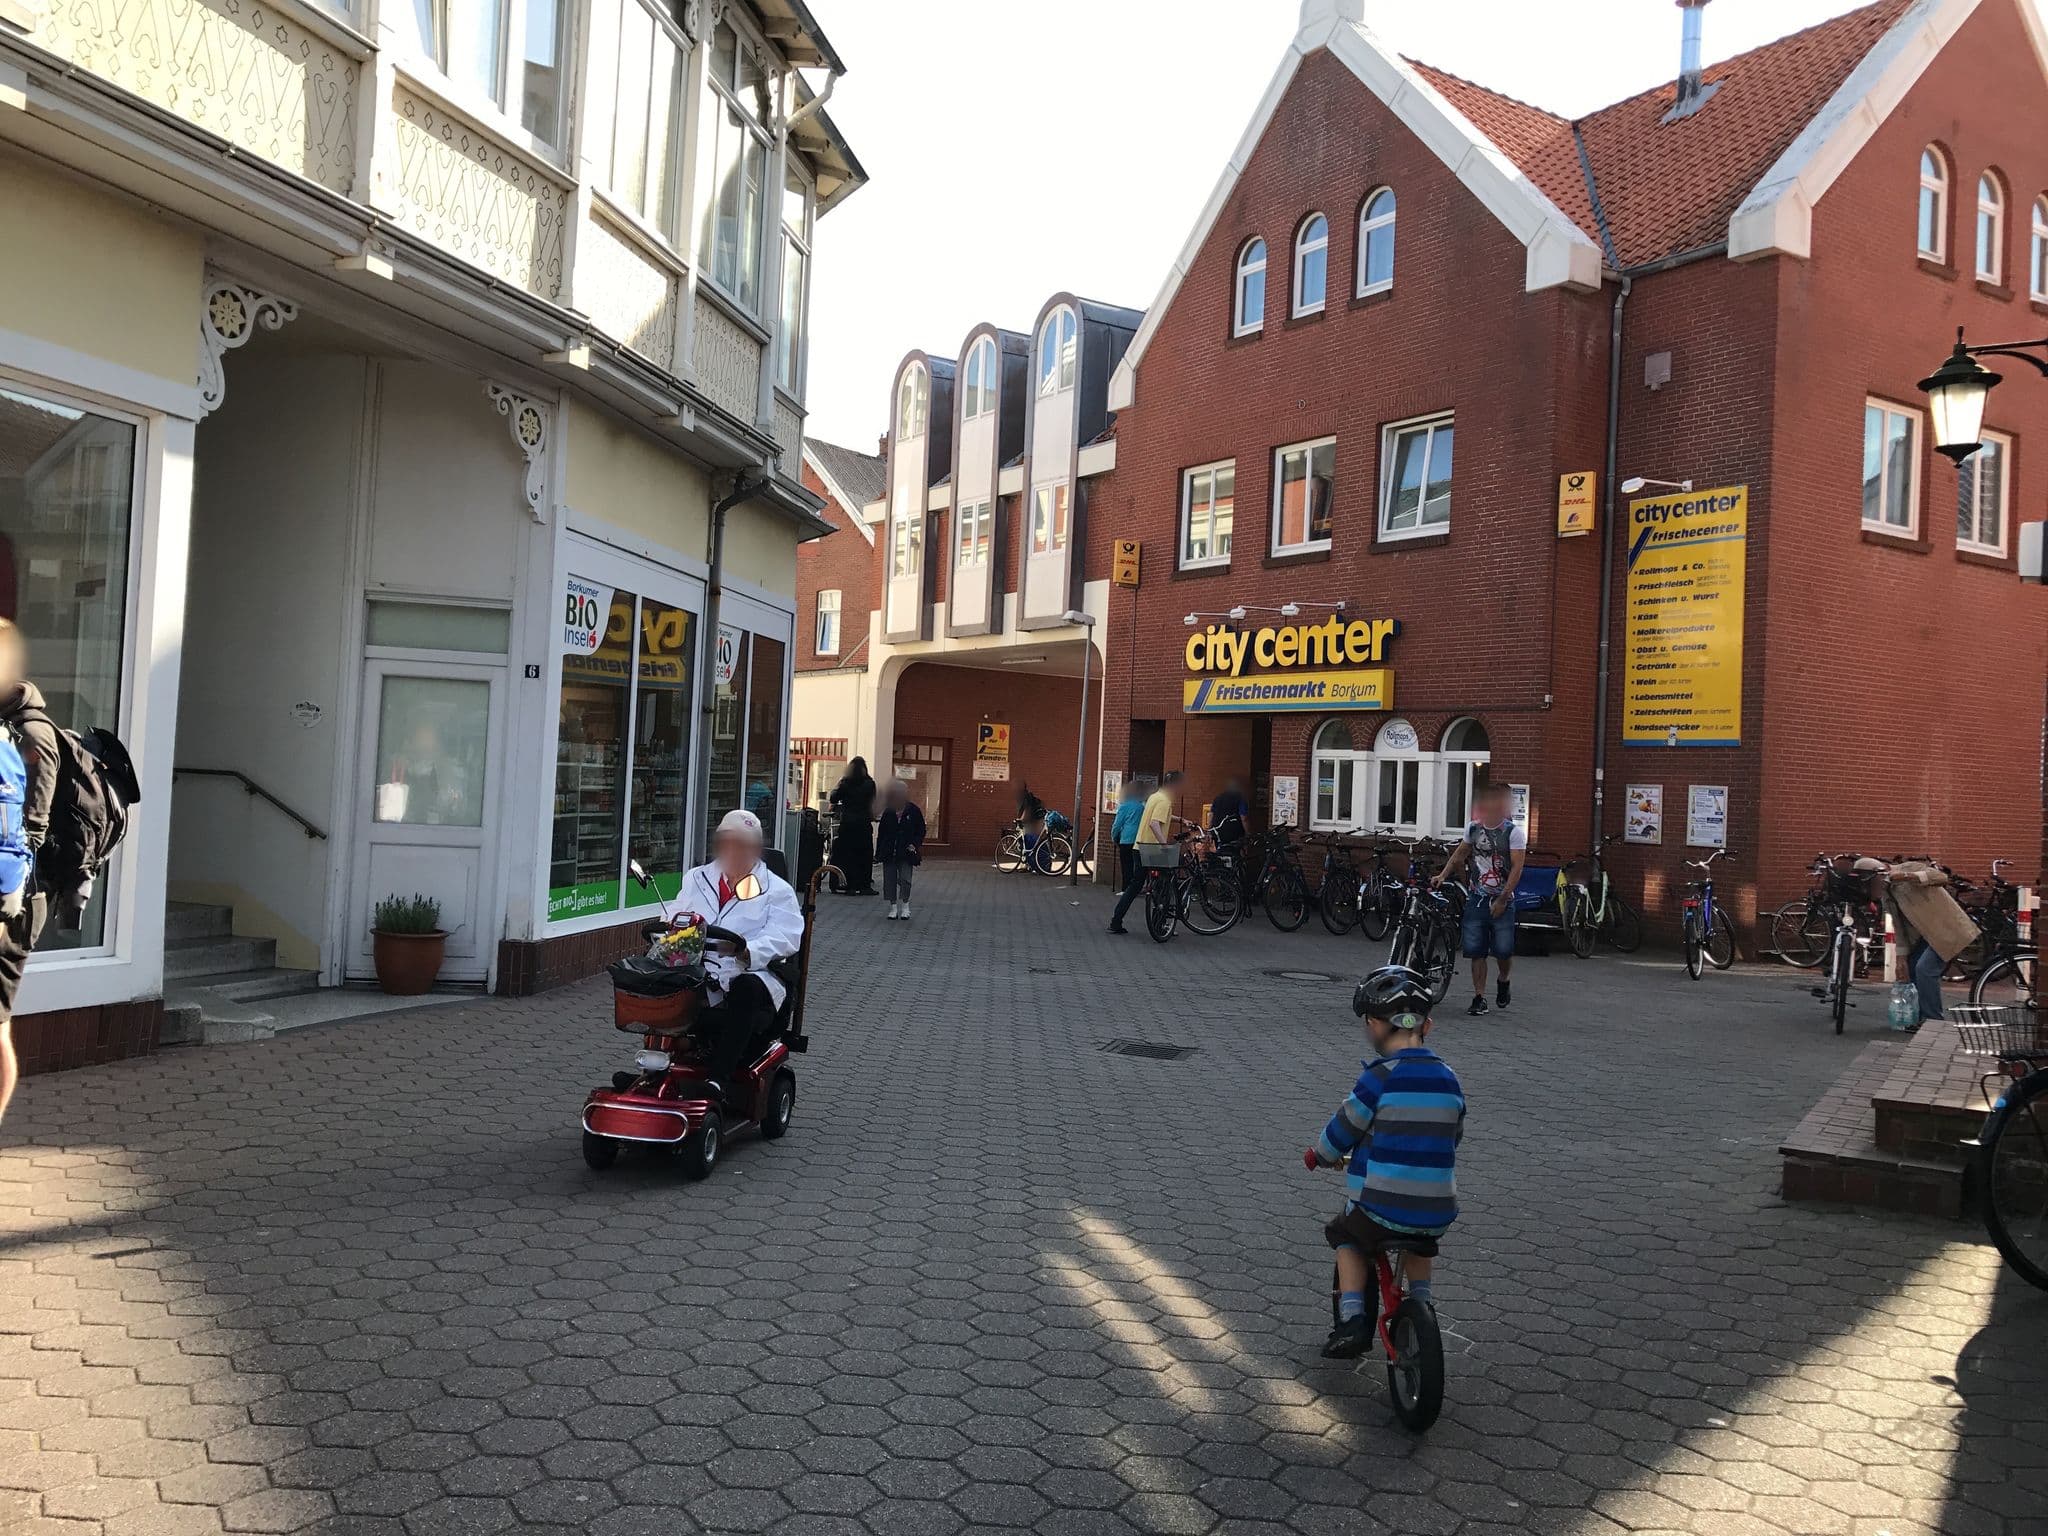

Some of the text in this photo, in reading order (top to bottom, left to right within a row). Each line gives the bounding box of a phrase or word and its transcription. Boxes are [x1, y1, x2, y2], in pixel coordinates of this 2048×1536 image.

[1635, 494, 1741, 523] city center
[1652, 523, 1739, 541] frischecenter
[1638, 565, 1679, 576] Rollmops
[567, 580, 599, 597] Borkumer
[1638, 596, 1678, 606] Schinken
[1692, 592, 1719, 601] Wurst
[564, 627, 589, 648] Insel
[1637, 624, 1716, 636] Molkereiprodukte
[1185, 613, 1395, 677] city center
[1636, 646, 1657, 654] Obst
[1636, 678, 1656, 686] Wein
[1216, 680, 1377, 701] frischemarkt Borkum
[1635, 692, 1694, 701] Lebensmittel
[1634, 708, 1693, 716] Zeitschriften
[980, 725, 993, 742] P
